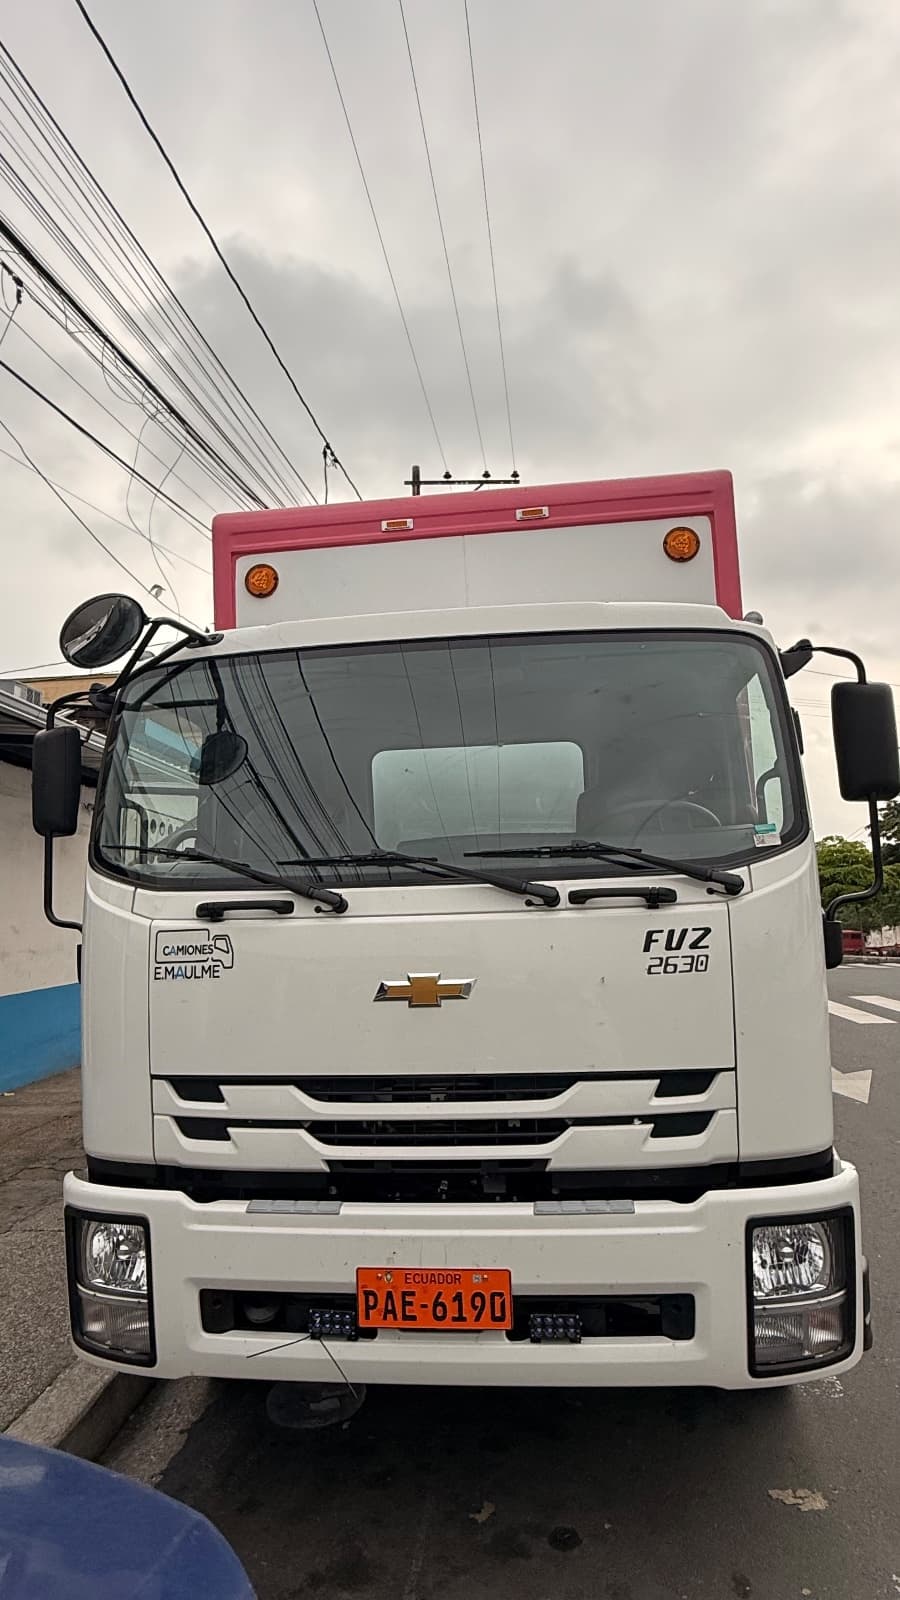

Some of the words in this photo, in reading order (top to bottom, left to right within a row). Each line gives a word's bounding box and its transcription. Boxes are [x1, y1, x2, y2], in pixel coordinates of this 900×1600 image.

[162, 944, 214, 957] CAMIONES
[153, 964, 221, 981] E.MAULME
[646, 954, 710, 975] 2630
[404, 1272, 462, 1285] ECUADOR
[362, 1289, 506, 1323] PAE-6190
